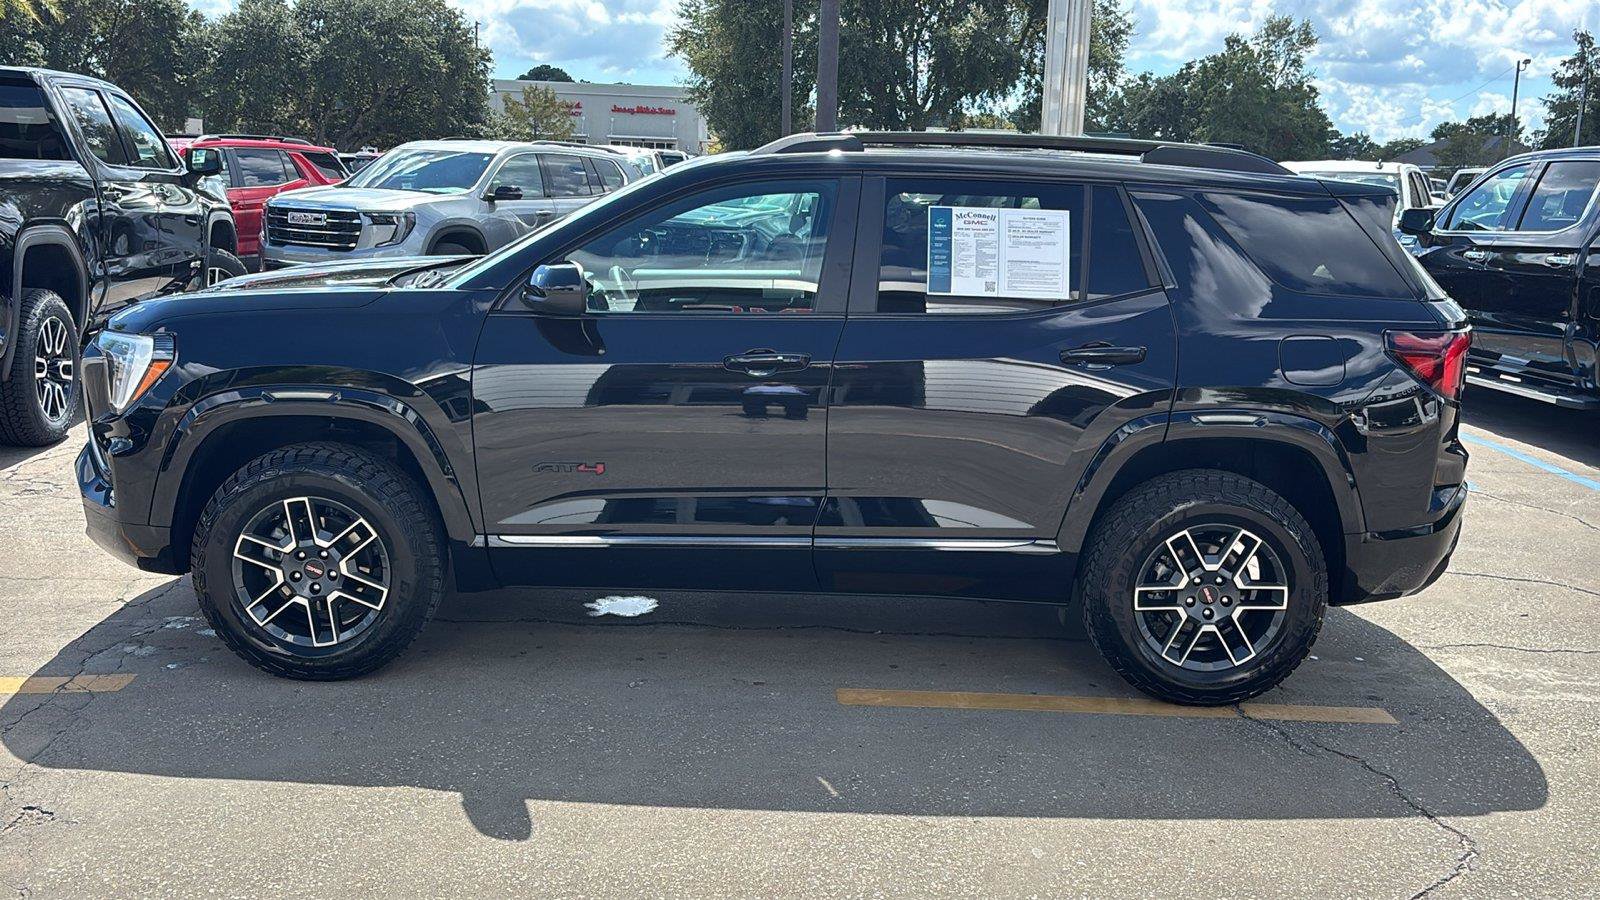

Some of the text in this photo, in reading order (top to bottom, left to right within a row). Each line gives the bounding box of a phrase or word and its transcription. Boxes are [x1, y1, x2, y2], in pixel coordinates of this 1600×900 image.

[288, 212, 327, 225] GMC
[954, 211, 997, 222] McConnell
[532, 462, 605, 475] AT4
